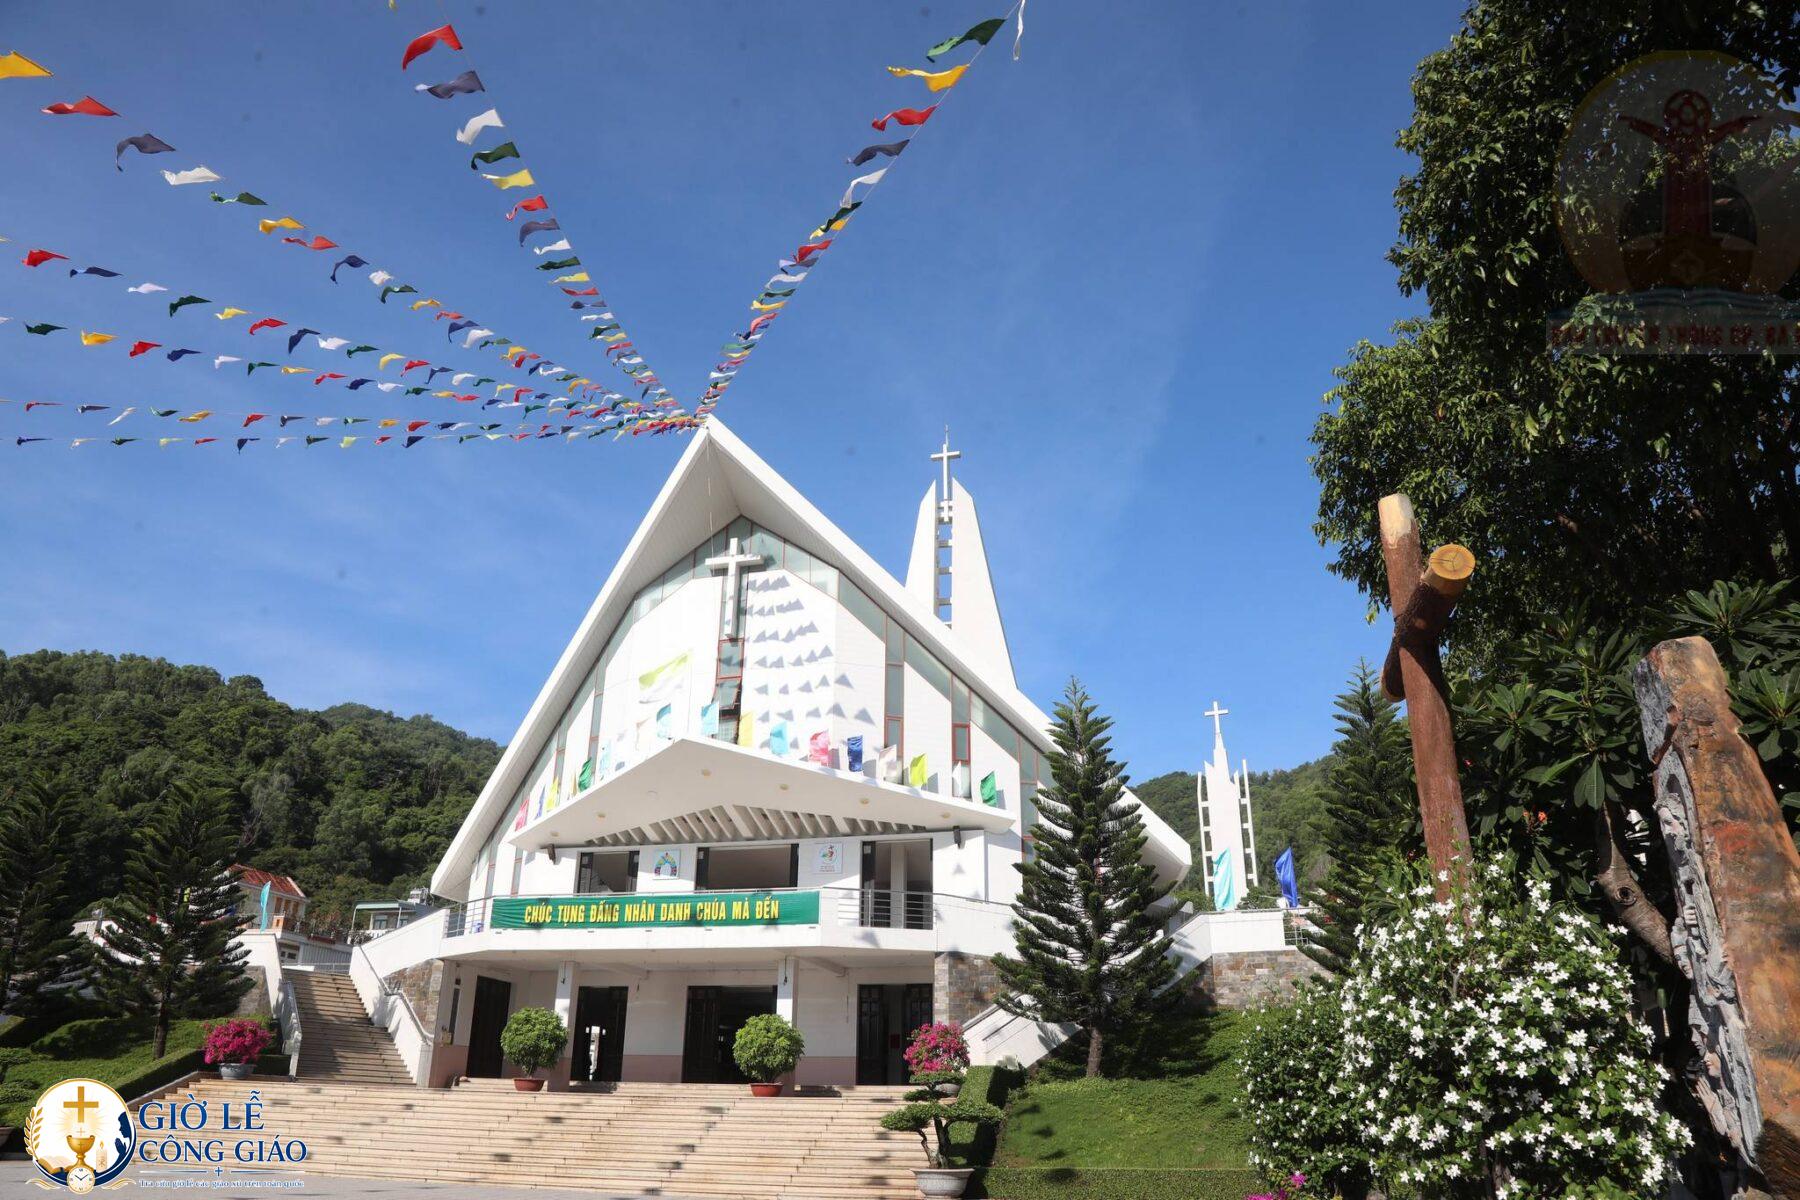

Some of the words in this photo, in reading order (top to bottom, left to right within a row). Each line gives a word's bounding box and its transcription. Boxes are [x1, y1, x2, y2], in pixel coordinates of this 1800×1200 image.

[525, 902, 553, 923] CHÚC
[558, 904, 587, 927] TỤNG
[590, 899, 620, 923] ĐẤNG
[625, 899, 656, 922] NHÂN
[660, 902, 692, 922] DANH
[696, 897, 727, 920] CHÚA
[732, 897, 750, 920] MÀ
[756, 895, 780, 919] ĐẾN
